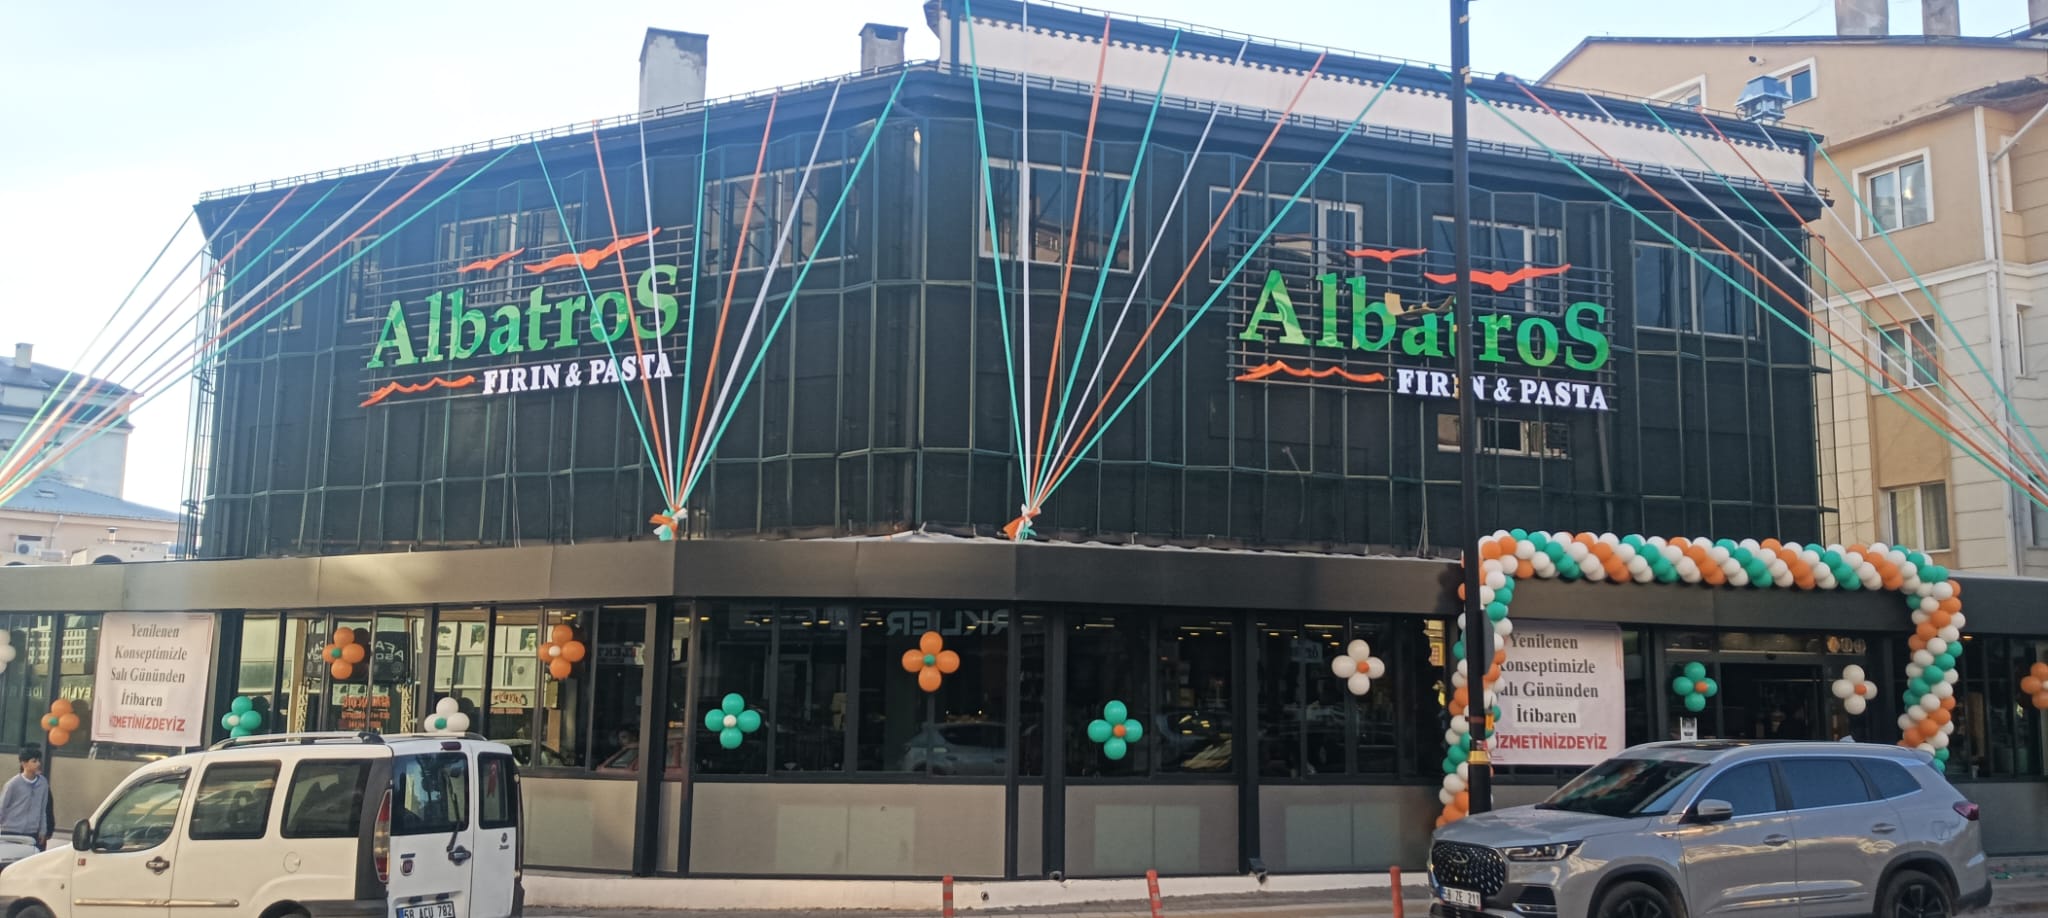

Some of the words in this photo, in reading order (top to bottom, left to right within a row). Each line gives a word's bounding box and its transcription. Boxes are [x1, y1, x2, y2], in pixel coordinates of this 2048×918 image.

[482, 364, 561, 395] FIRIN
[565, 362, 582, 387] &
[589, 353, 672, 385] PASTA
[1493, 377, 1512, 402] &
[1519, 379, 1608, 411] PASTA
[131, 624, 180, 638] Yenilenen
[1511, 632, 1578, 649] Yenilenen
[115, 645, 188, 663] Konseptimizle
[111, 667, 128, 681] Salı
[130, 667, 185, 683] Gününden
[121, 688, 163, 707] İtibaren
[1500, 681, 1518, 696] alı
[1523, 681, 1599, 698] Gününden
[1516, 704, 1577, 723] İtibaren
[438, 904, 452, 917] 782
